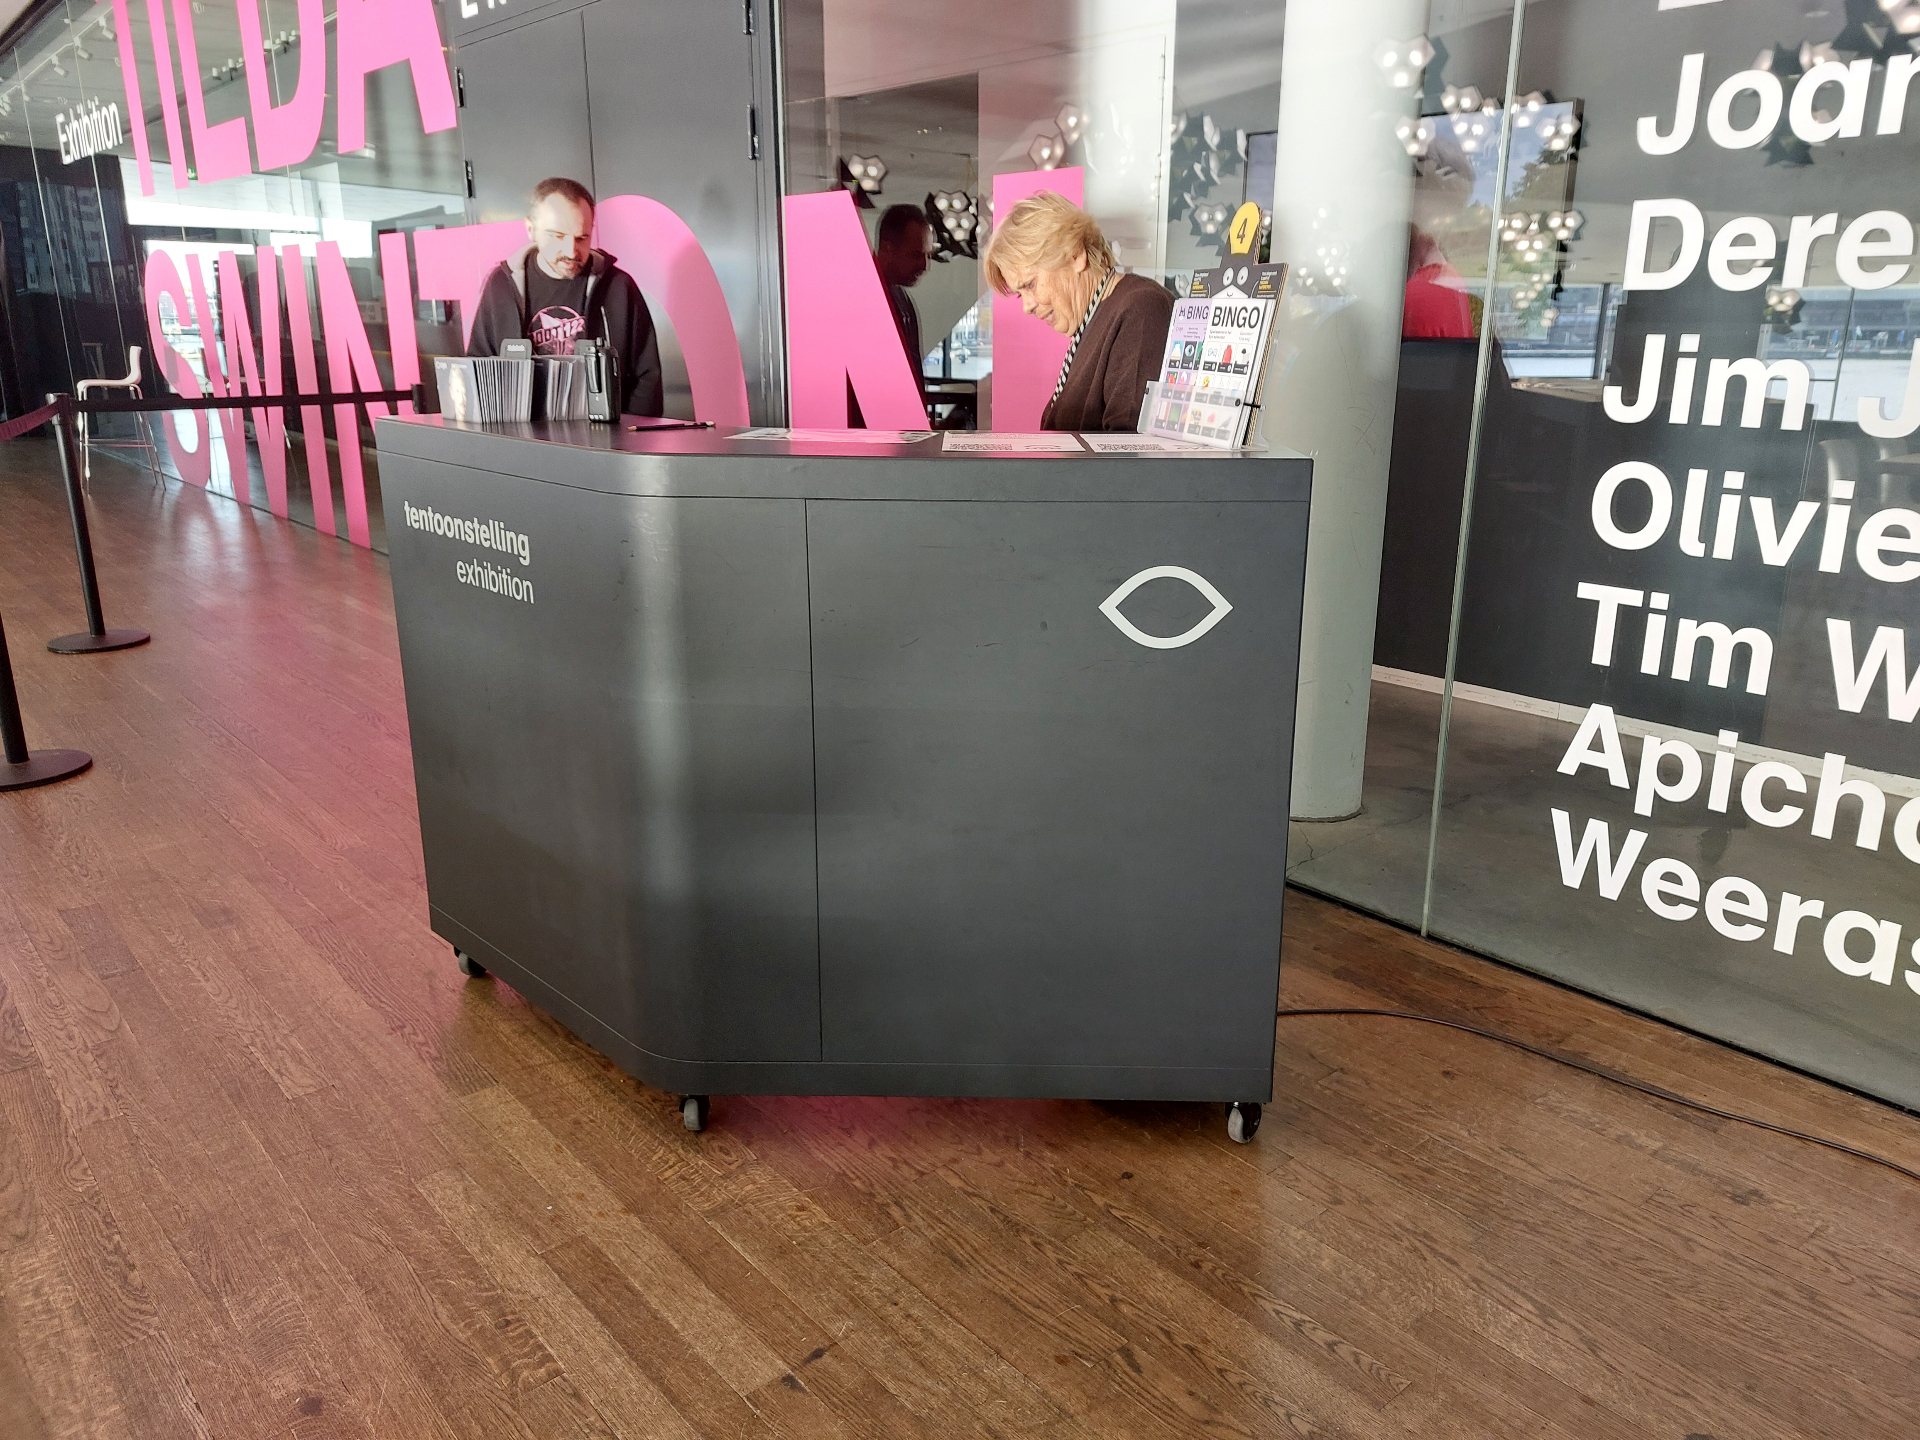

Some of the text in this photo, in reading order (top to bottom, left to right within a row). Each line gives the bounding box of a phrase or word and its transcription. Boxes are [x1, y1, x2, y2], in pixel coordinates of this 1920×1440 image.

[55, 95, 123, 165] Exhibition
[1236, 217, 1248, 245] 4
[1622, 198, 1914, 292] Dere
[1211, 305, 1261, 329] BINGO
[1602, 333, 1812, 431] Jim
[404, 500, 530, 566] tentoonstelling
[456, 558, 535, 604] exhibition
[1576, 581, 1774, 696] Tim
[1550, 807, 1920, 1000] Weera
